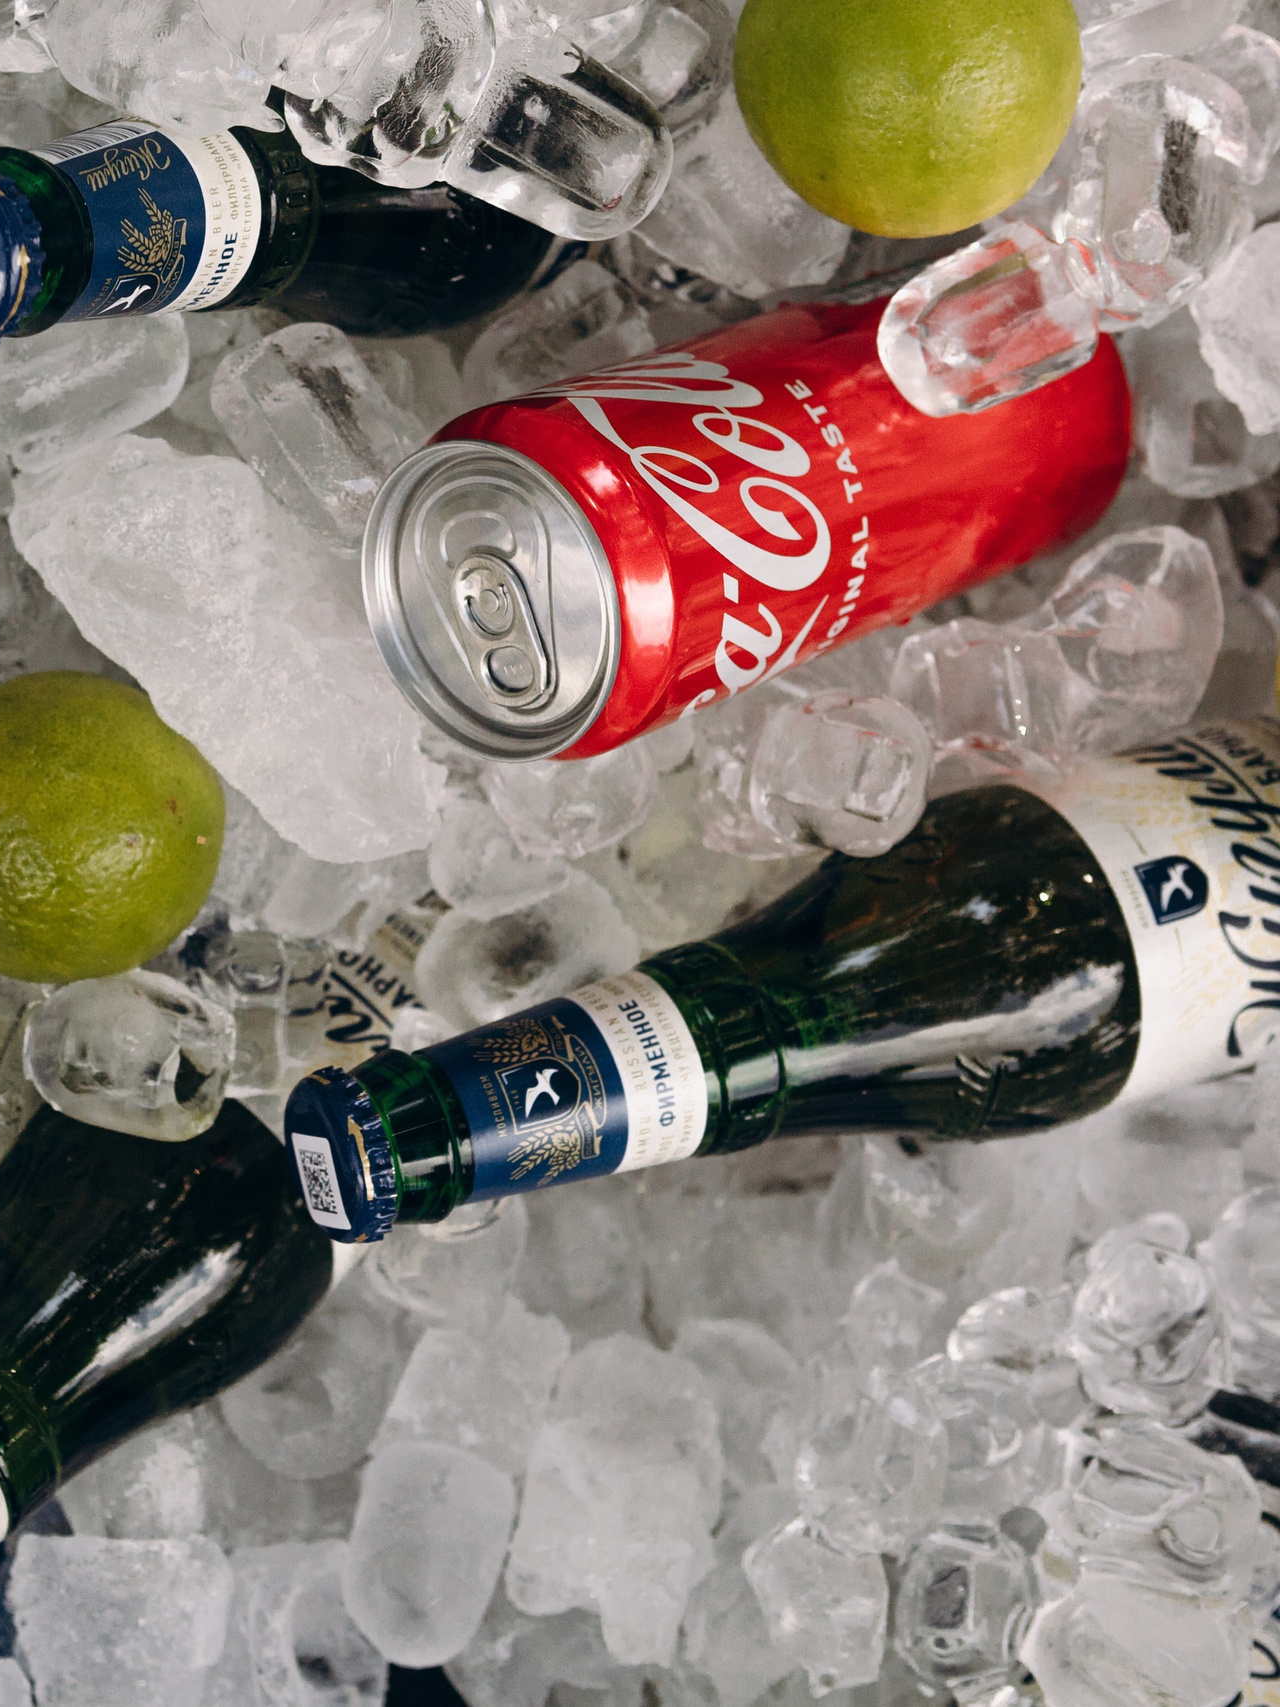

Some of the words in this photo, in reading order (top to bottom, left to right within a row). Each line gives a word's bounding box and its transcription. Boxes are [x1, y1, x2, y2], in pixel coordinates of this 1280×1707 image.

[209, 185, 221, 233] BEER
[239, 176, 252, 248] РЕСТОРАНА
[784, 376, 863, 502] TASTE
[607, 1015, 647, 1091] RUSSIAN
[617, 998, 676, 1128] ФИРМЕННОЕ
[656, 1009, 687, 1060] РЕЦЕПТУ
[479, 1073, 508, 1138] МОСПИВКОМ
[574, 1045, 602, 1109] ЖИГУЛИ
